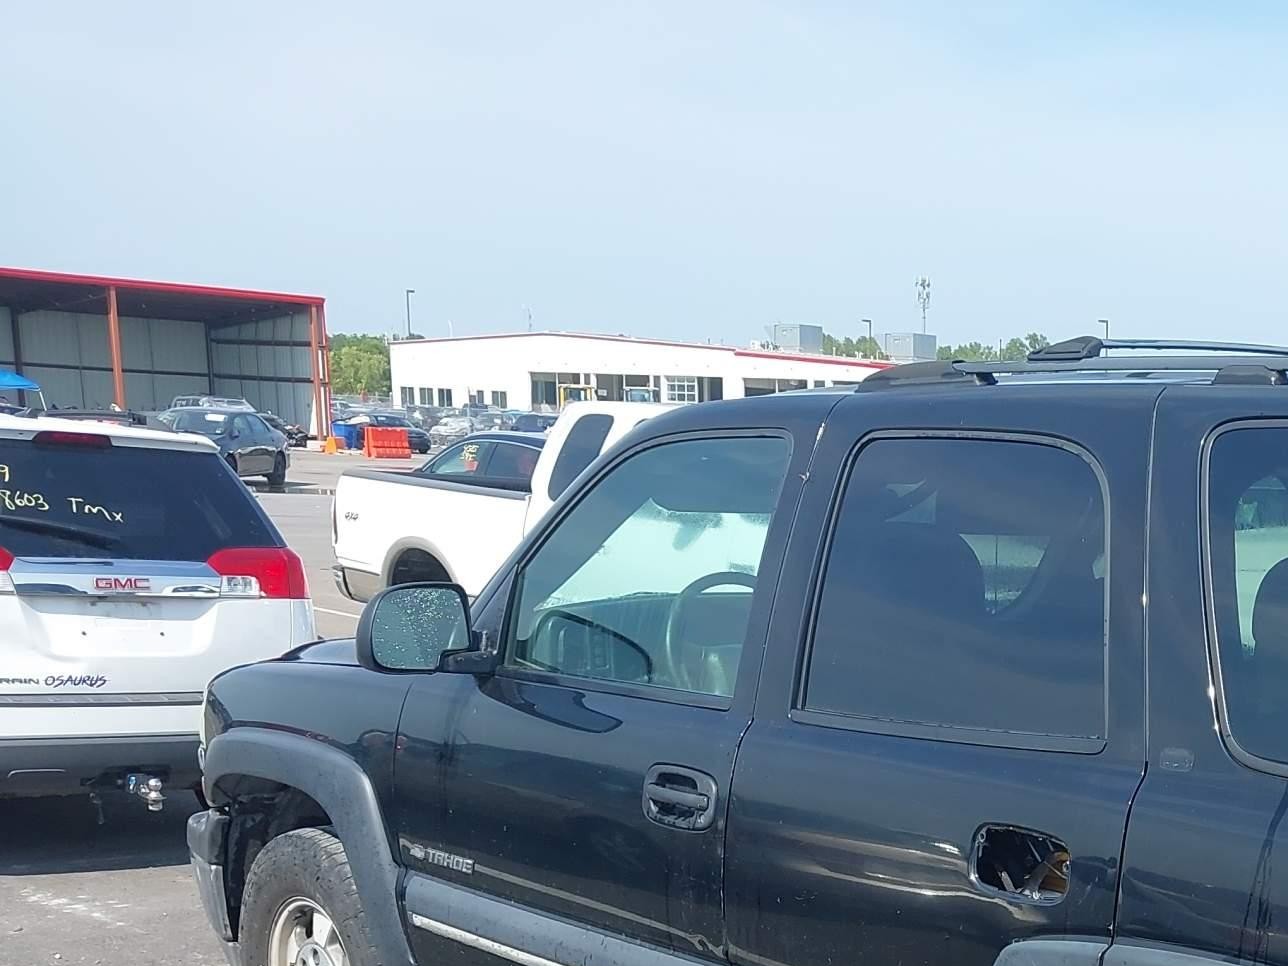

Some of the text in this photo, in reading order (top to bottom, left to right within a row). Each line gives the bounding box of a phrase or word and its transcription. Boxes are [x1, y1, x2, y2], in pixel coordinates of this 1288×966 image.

[94, 577, 151, 590] GMC
[44, 674, 108, 689] OSAURUS
[425, 847, 475, 875] TAHOE
